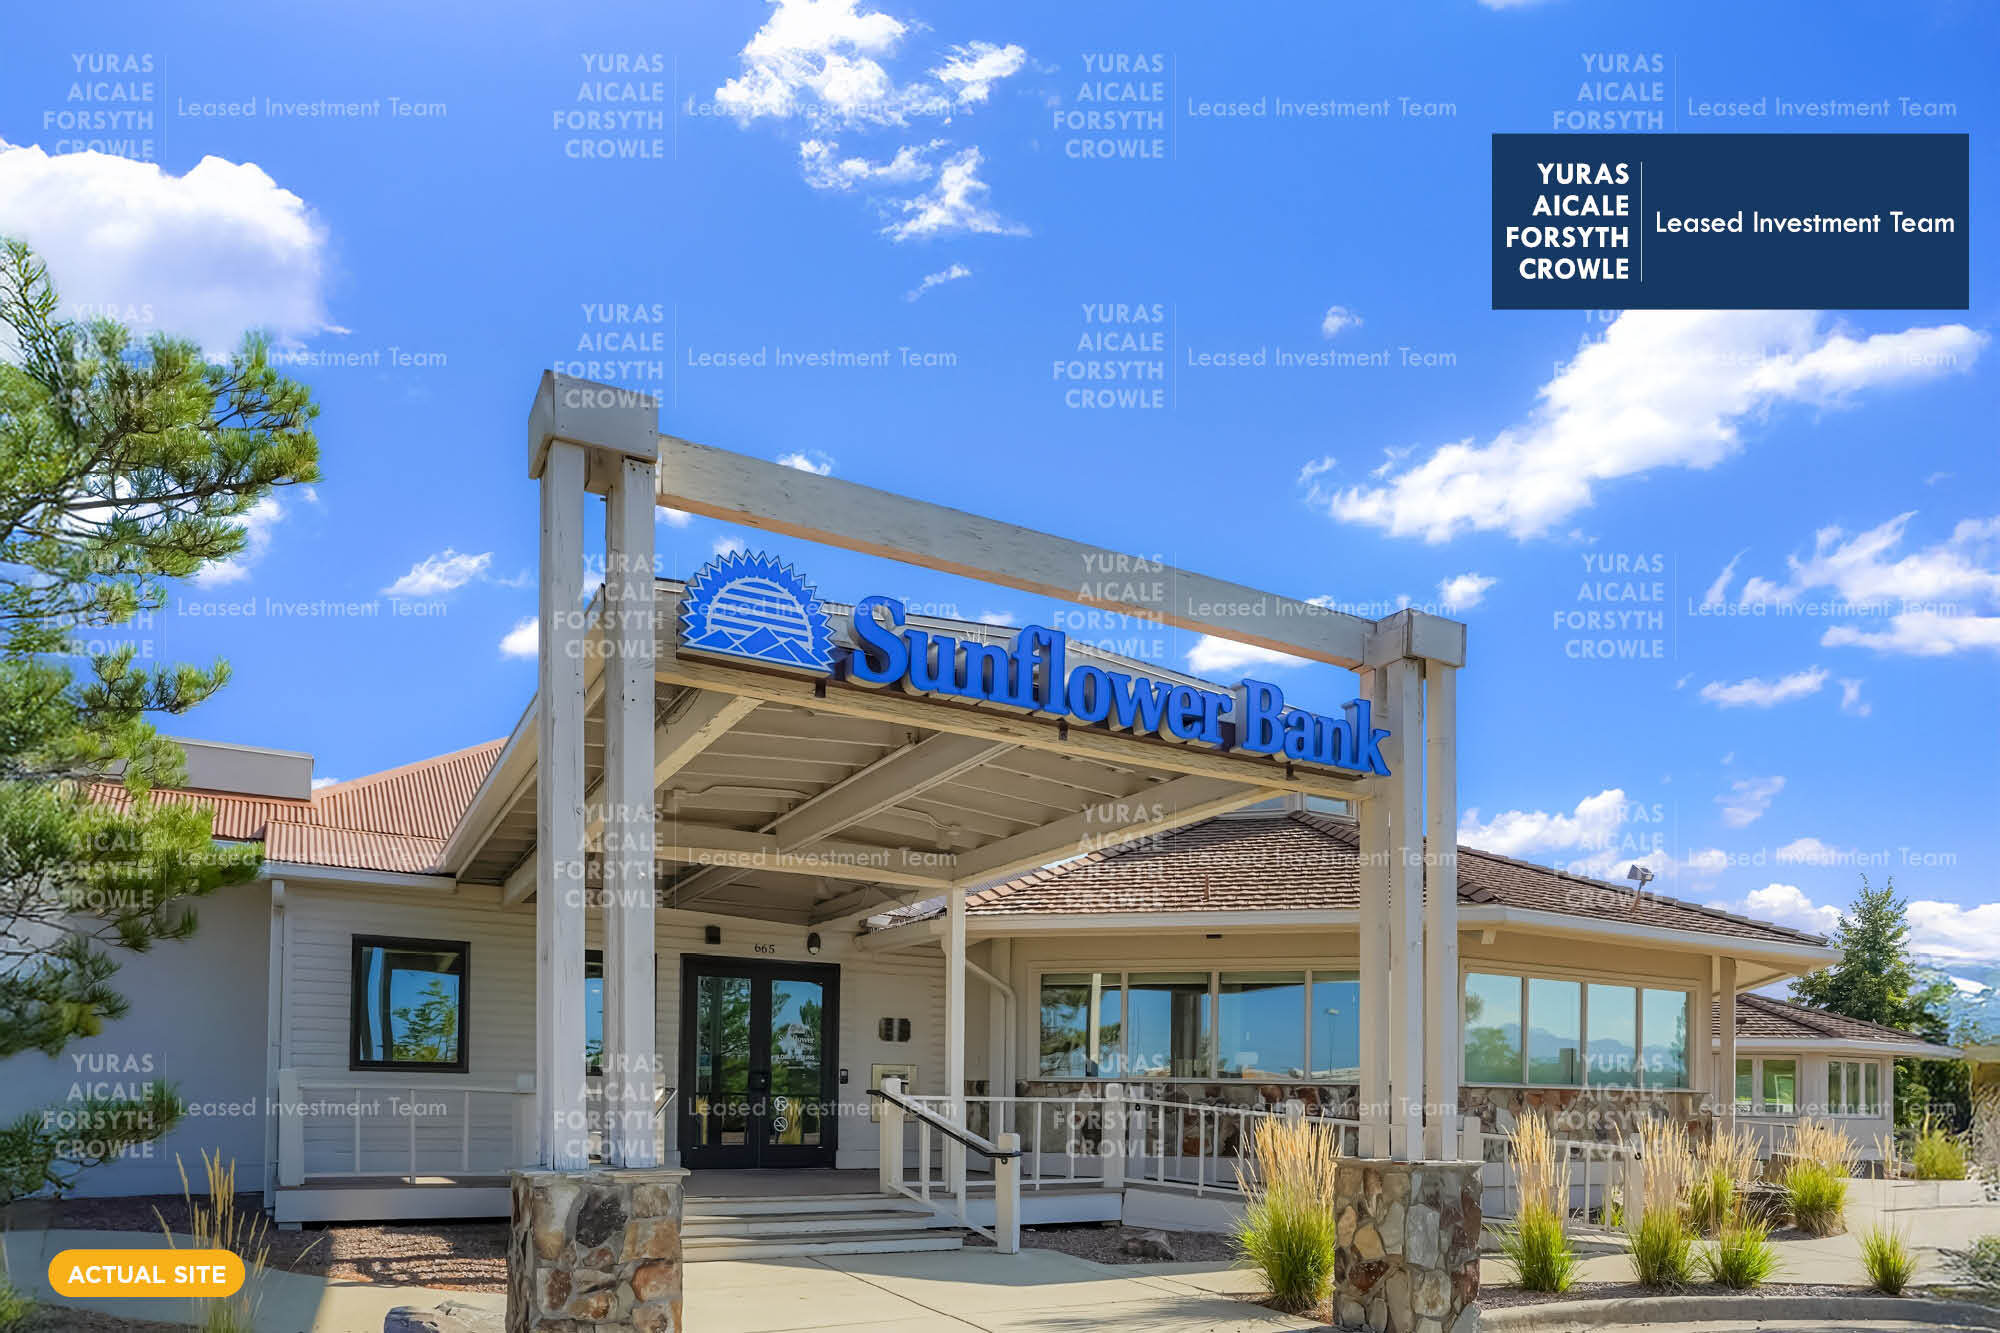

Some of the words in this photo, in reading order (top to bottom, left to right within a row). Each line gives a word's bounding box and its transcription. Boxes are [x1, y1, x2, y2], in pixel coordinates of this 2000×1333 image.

[852, 595, 1233, 745] Sunflower
[1240, 677, 1391, 777] Bank
[754, 943, 776, 954] 665
